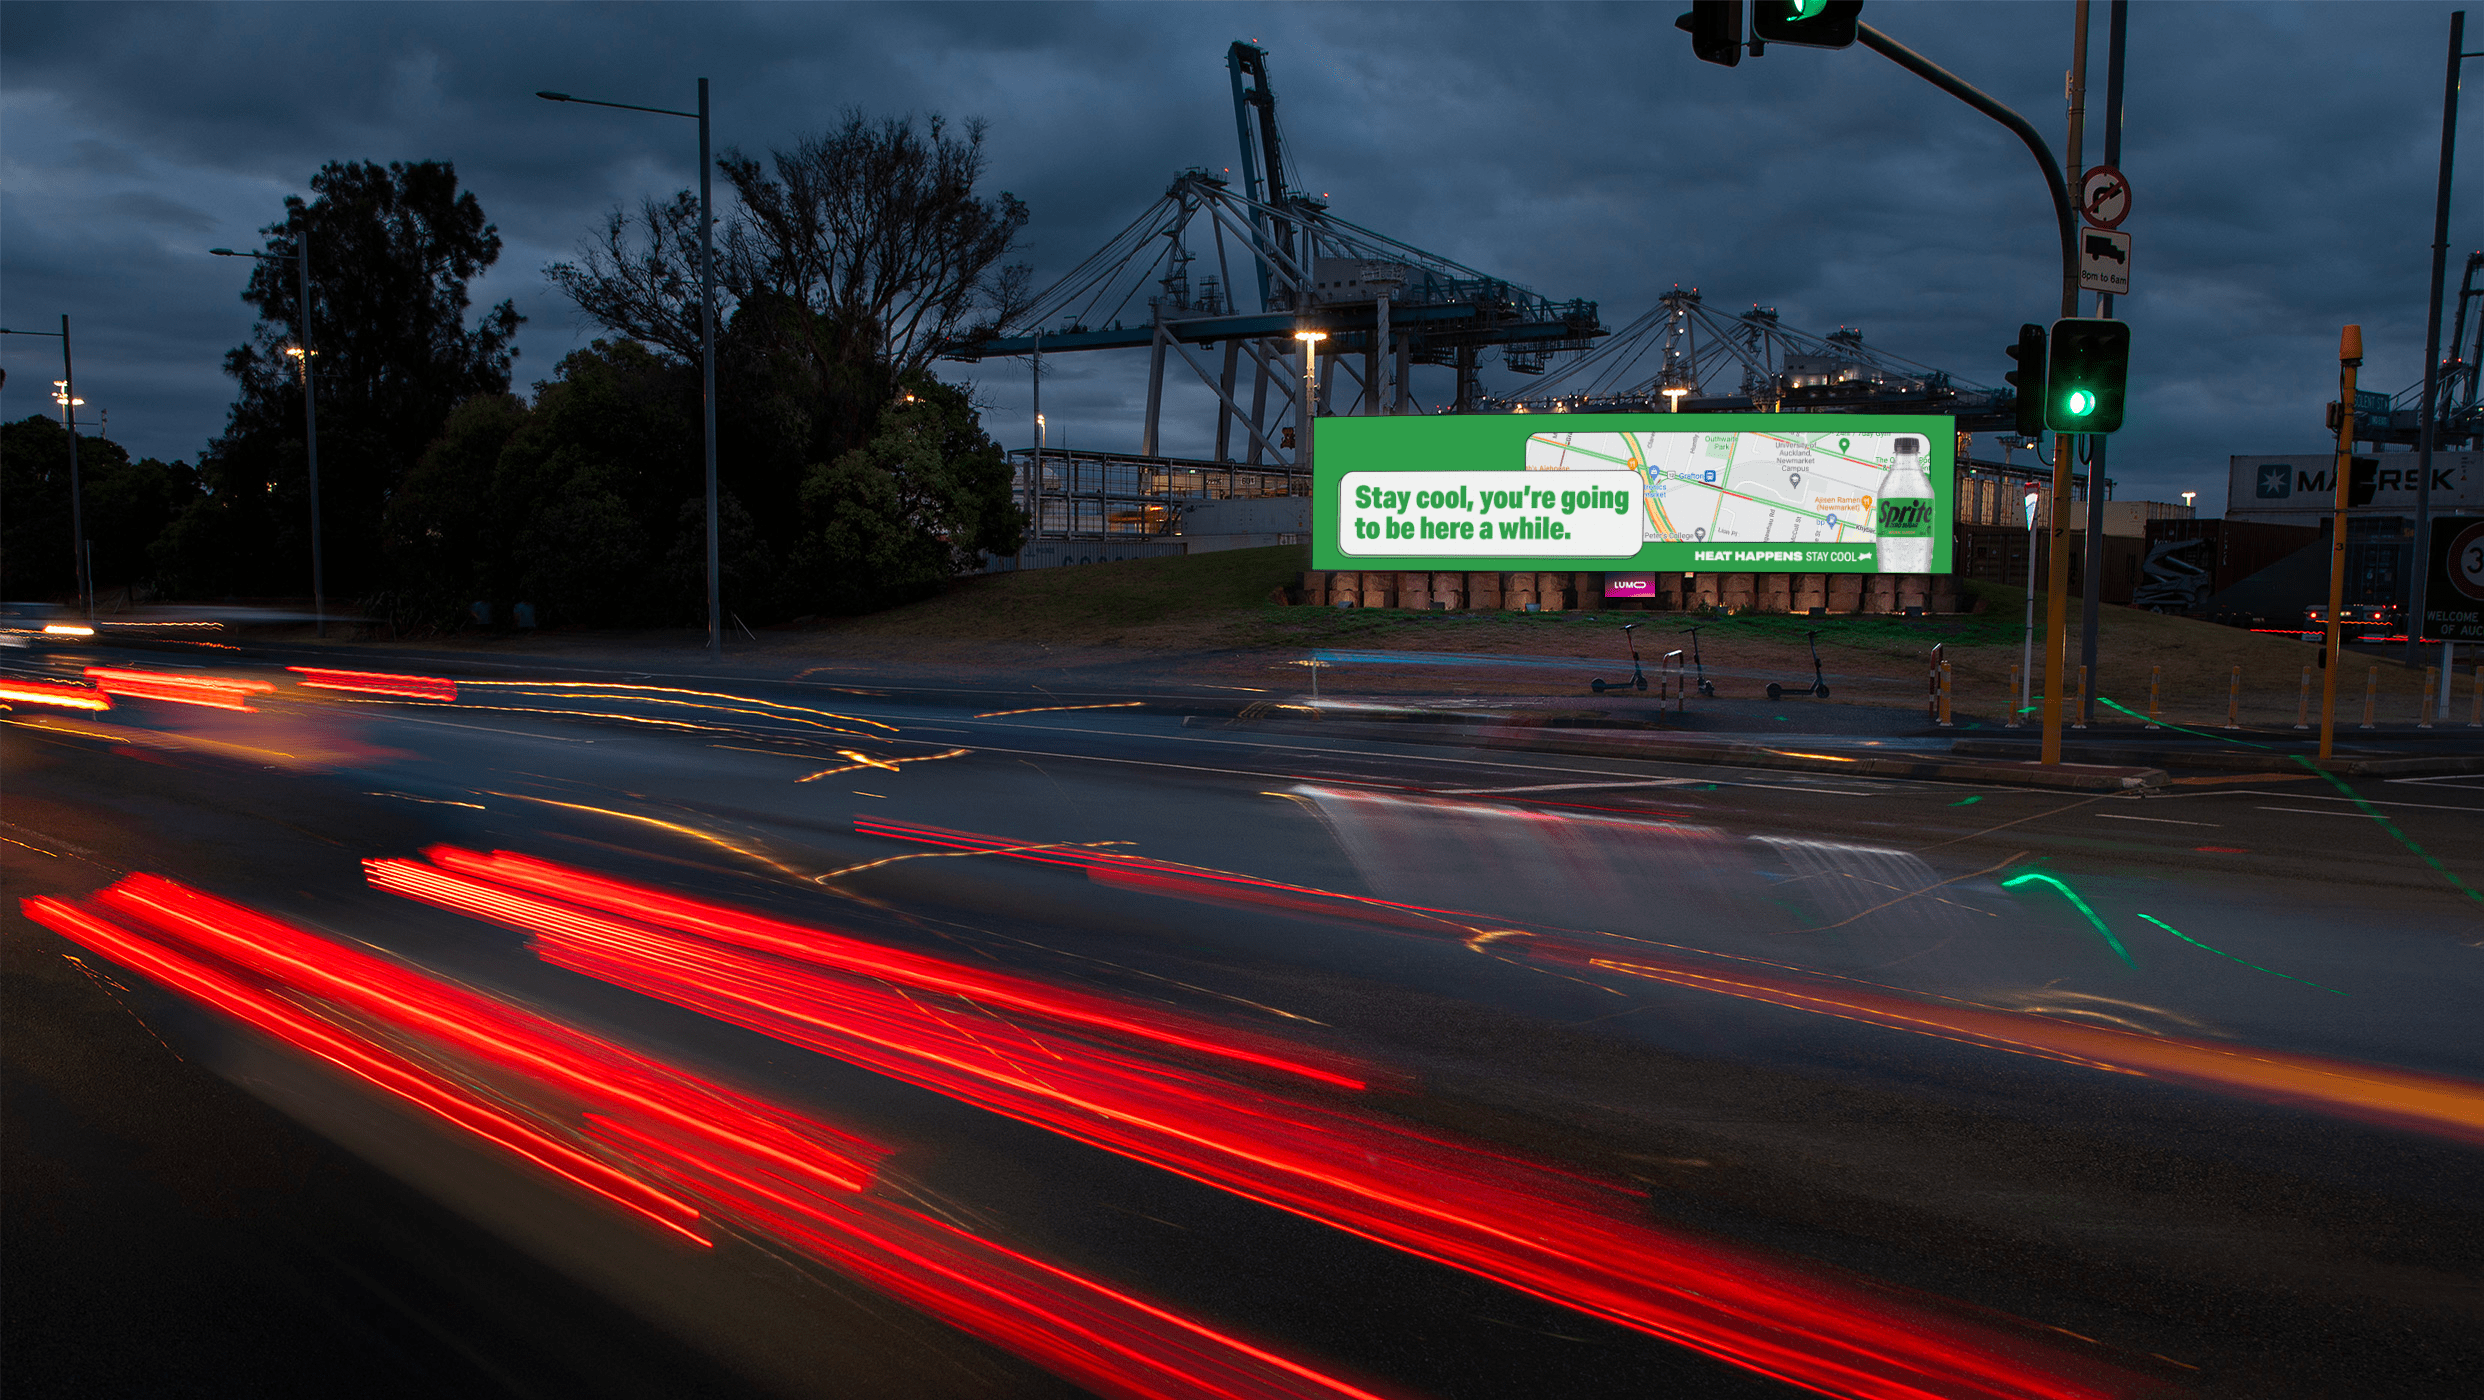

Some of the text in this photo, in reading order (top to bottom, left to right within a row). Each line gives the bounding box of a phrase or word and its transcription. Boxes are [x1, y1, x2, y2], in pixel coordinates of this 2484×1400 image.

[2081, 270, 2127, 285] 8pm to 6am
[1775, 441, 1808, 450] University
[1781, 465, 1810, 473] Campus
[1679, 472, 1704, 480] Grafton
[2297, 469, 2456, 491] MRSK
[1356, 485, 1629, 515] Stay cool, you're going
[1837, 496, 1861, 504] Ramen
[1816, 504, 1860, 512] (Newmarket)
[1879, 499, 1933, 528] Sprite
[1355, 516, 1571, 540] to be here a while.
[1669, 531, 1694, 540] College
[1695, 551, 1857, 562] HEAT HAPPENS STAY COOL
[1614, 581, 1646, 589] LUMO
[2426, 610, 2480, 623] WELCOME
[2440, 624, 2484, 637] OF AUC
